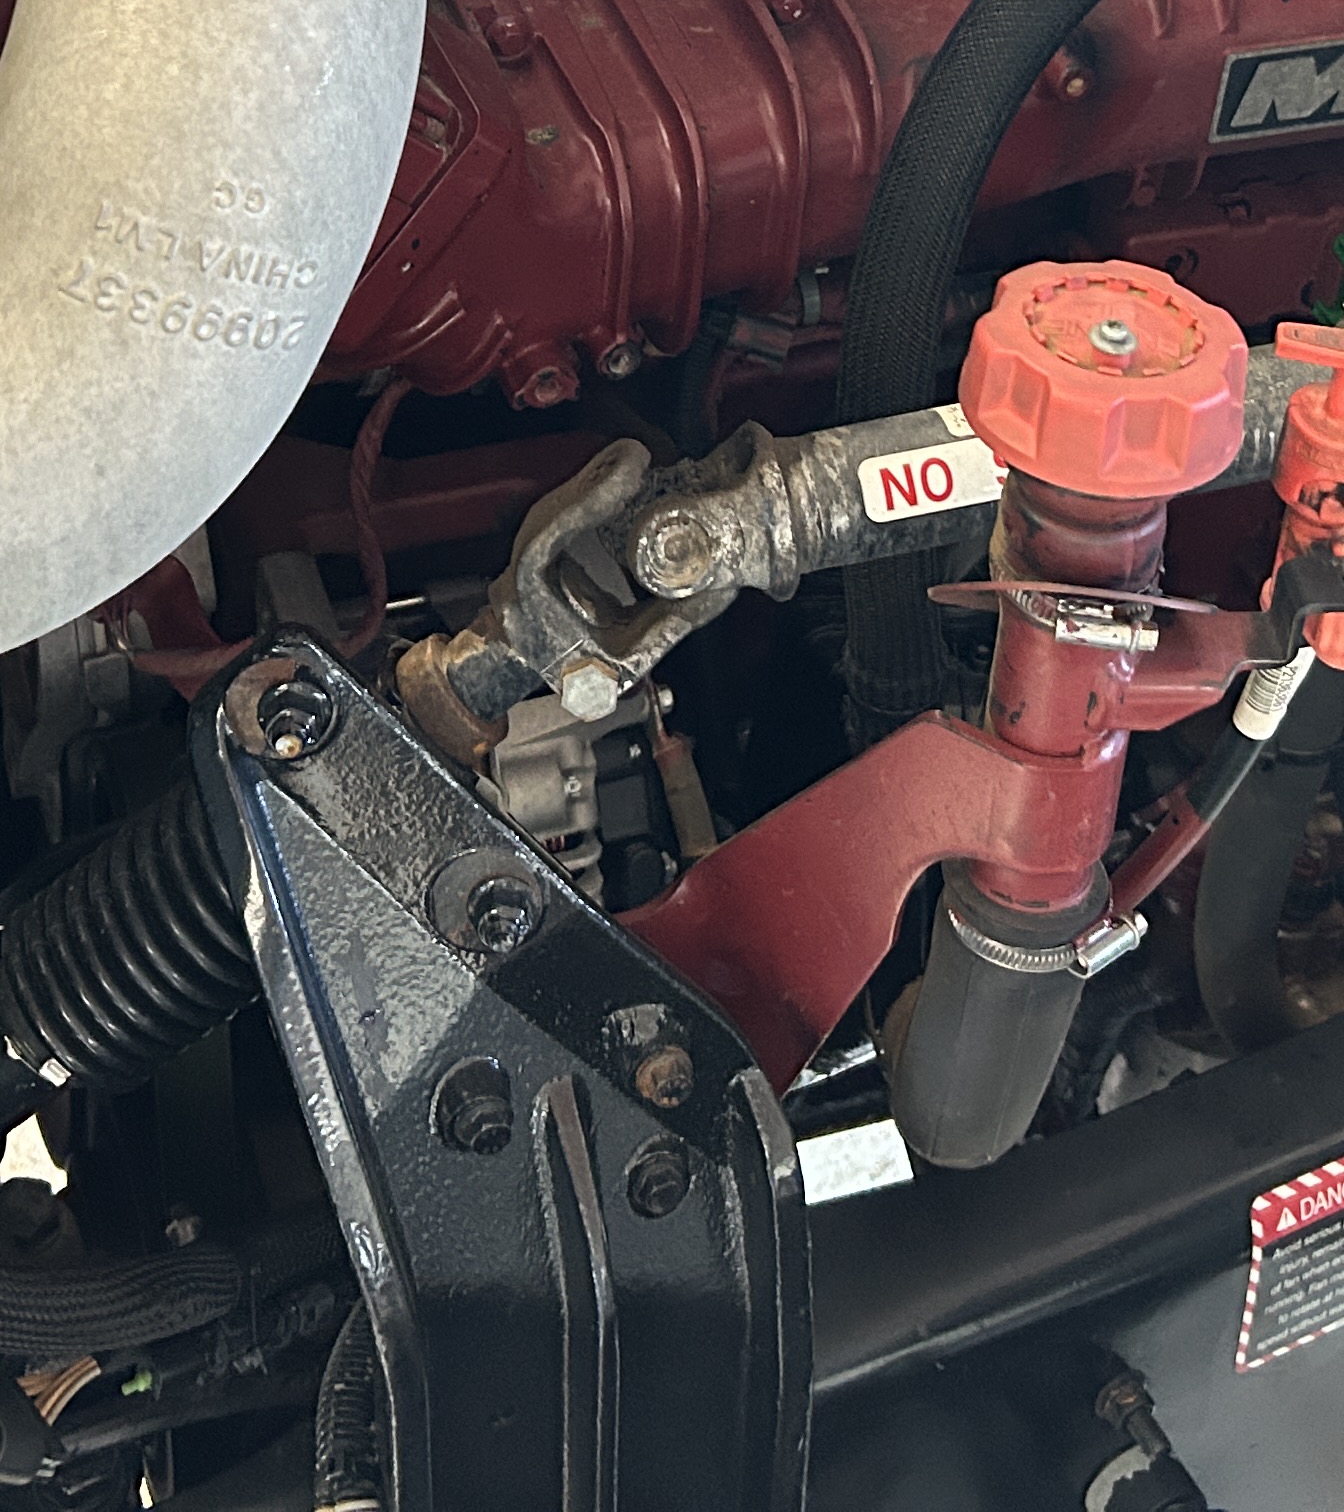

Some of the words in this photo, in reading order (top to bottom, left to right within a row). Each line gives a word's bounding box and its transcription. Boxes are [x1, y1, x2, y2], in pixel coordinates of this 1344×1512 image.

[197, 240, 321, 290] CHINA
[57, 255, 308, 351] 20999337
[879, 457, 954, 512] NO
[1272, 1238, 1303, 1260] Avoid
[1303, 1221, 1342, 1246] serious
[1301, 1261, 1330, 1281] when
